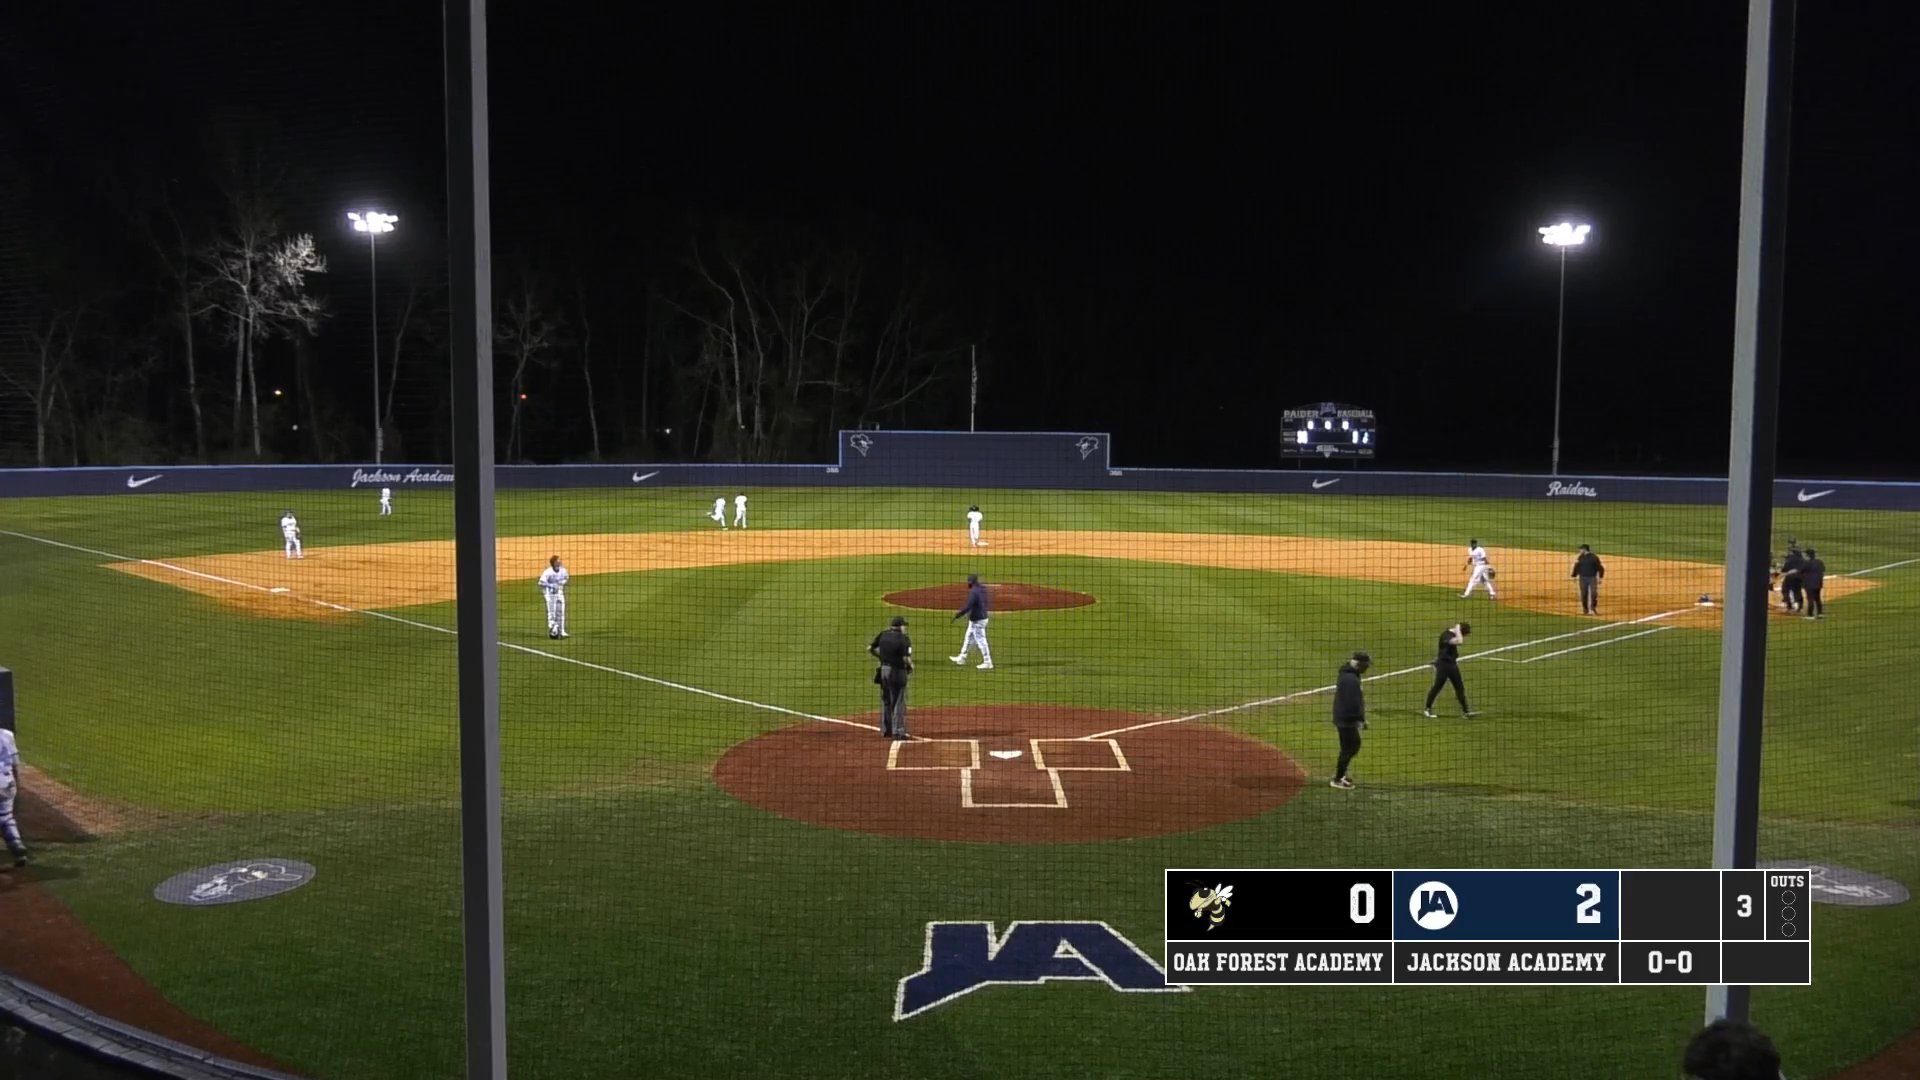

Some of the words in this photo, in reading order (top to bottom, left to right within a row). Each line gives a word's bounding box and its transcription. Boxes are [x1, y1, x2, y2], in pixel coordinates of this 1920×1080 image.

[1283, 410, 1319, 418] RAIDER
[1337, 410, 1374, 418] BASEBALL
[351, 468, 401, 488] Jackson
[403, 468, 454, 483] Academ
[1546, 481, 1598, 497] Raiders
[893, 920, 1194, 1022] JA
